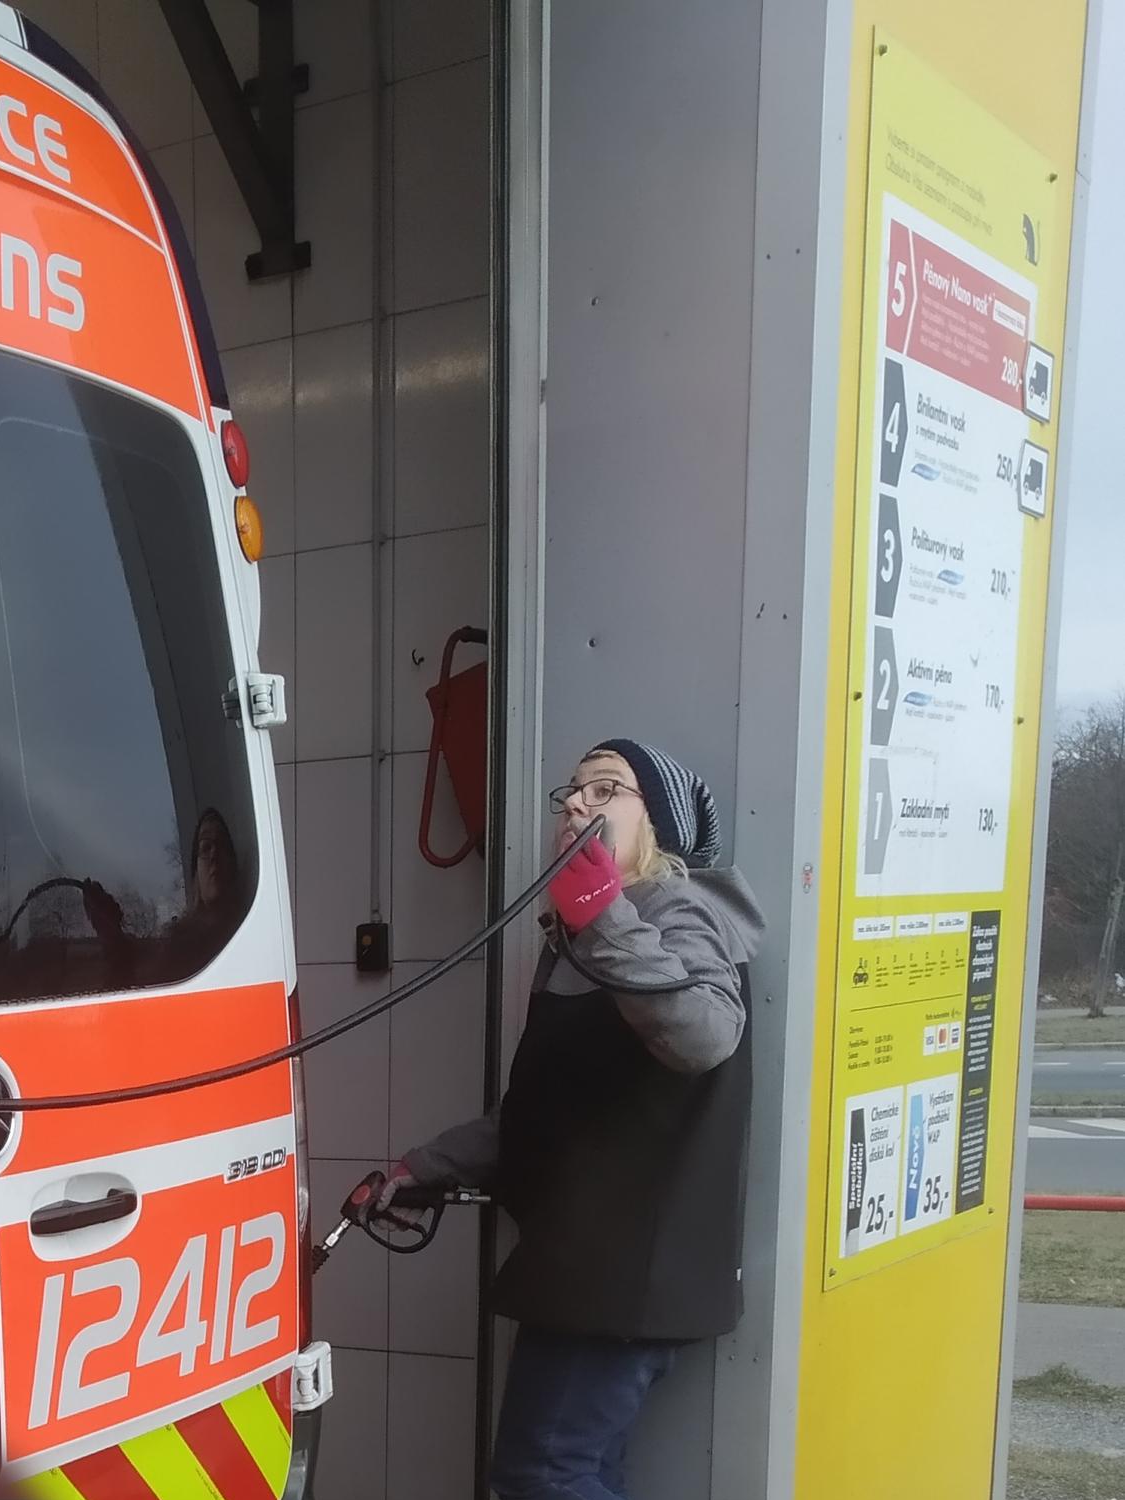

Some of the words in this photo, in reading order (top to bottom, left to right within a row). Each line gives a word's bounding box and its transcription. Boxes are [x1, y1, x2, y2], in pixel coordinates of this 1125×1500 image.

[891, 261, 907, 317] 5
[951, 275, 972, 306] Nano
[1001, 356, 1023, 392] 280,-
[885, 402, 900, 453] 4
[950, 411, 966, 432] vosk
[996, 453, 1018, 487] 250,-
[880, 529, 895, 583] 3
[949, 541, 965, 561] vosk
[990, 568, 1012, 599] 210,-
[876, 659, 891, 710] 2
[985, 684, 1005, 713] 170,-
[874, 792, 884, 840] 1
[978, 808, 999, 835] 130,-
[865, 1193, 894, 1234] 25,-
[923, 1175, 950, 1215] 35,-
[27, 1211, 286, 1430] 12412
